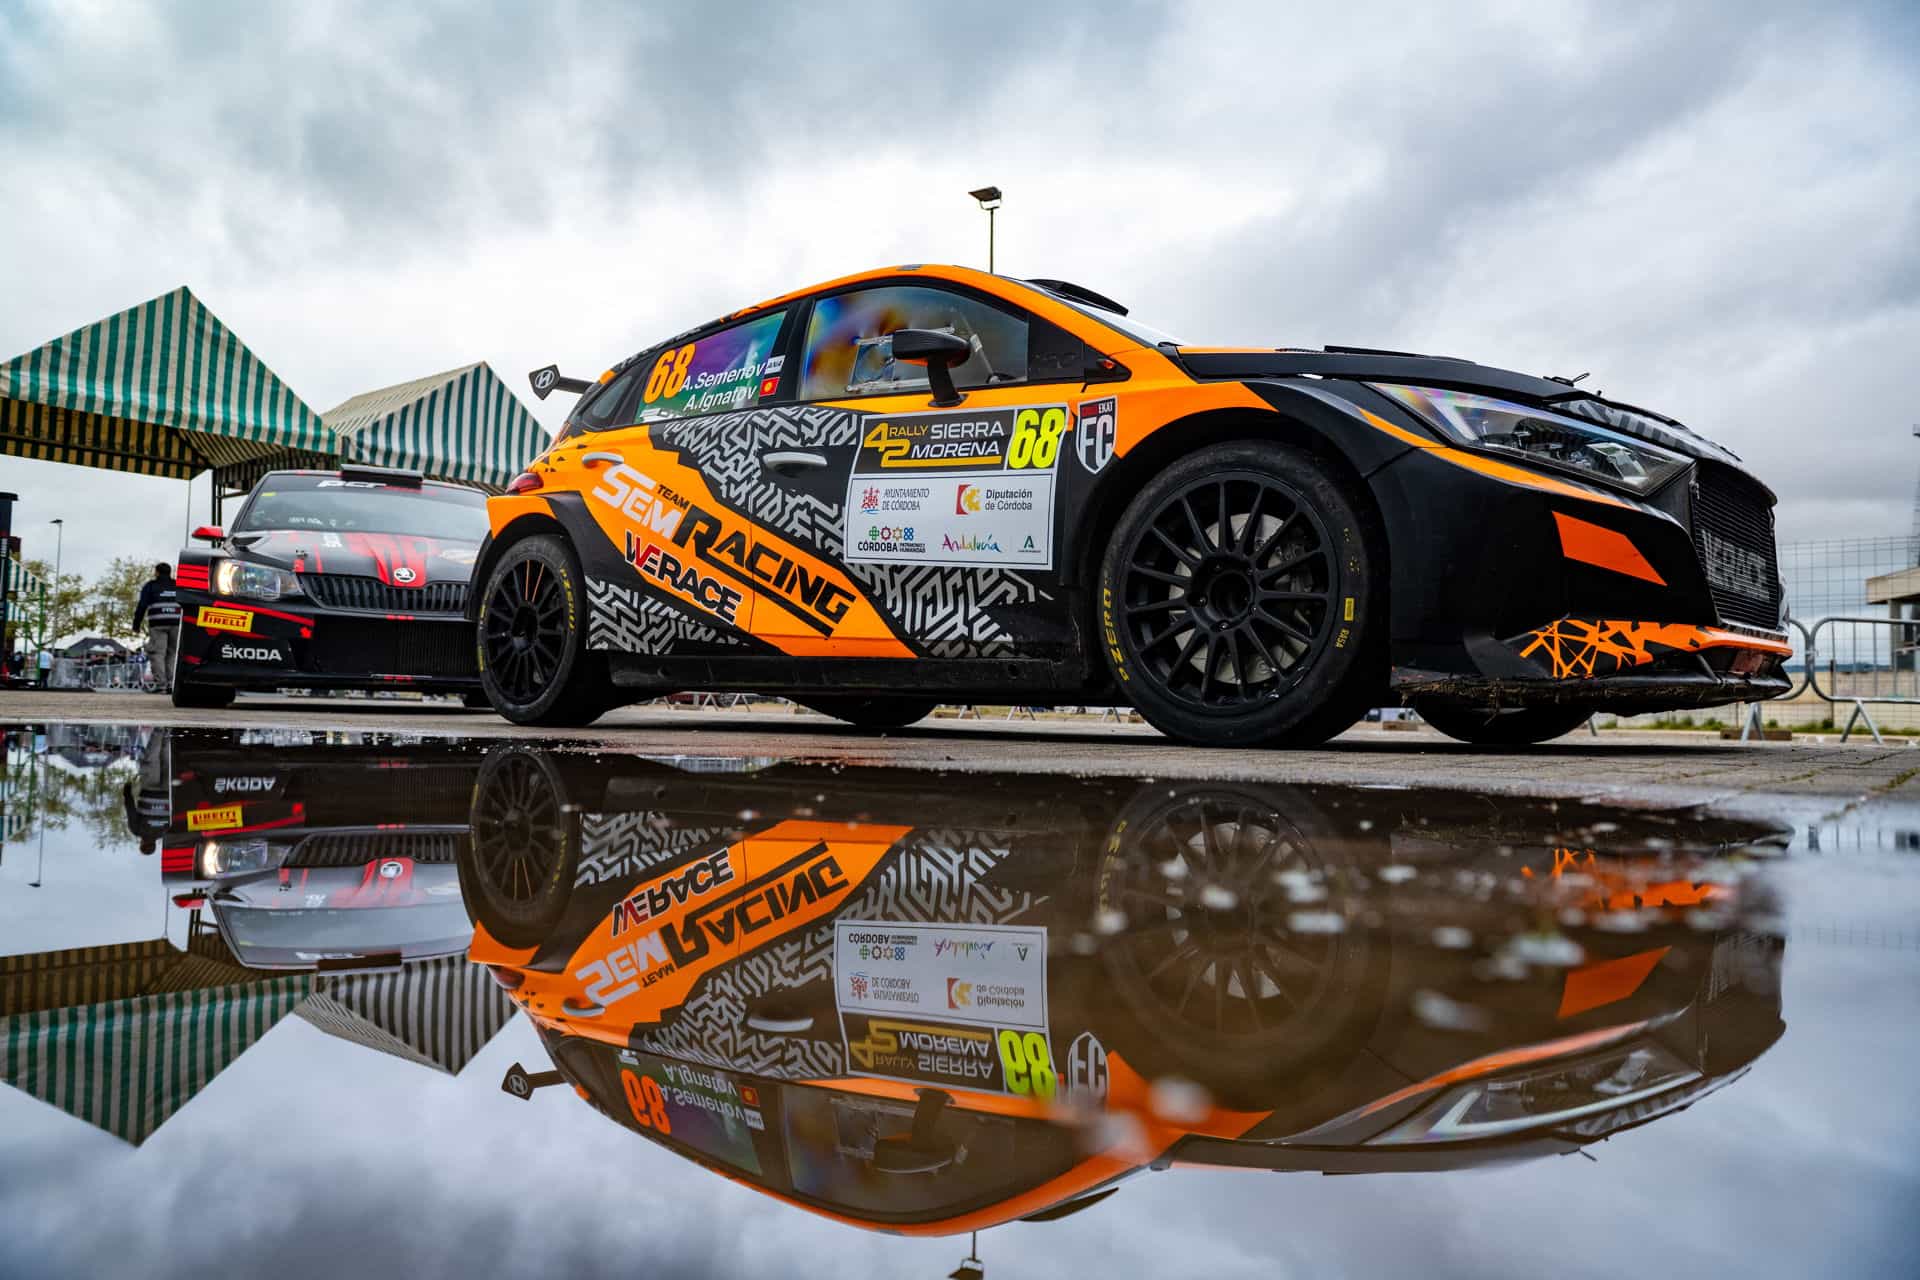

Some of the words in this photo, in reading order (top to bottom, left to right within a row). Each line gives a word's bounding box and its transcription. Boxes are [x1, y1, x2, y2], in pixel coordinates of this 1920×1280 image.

[643, 343, 696, 404] 68
[679, 361, 766, 392] A.Semenov
[683, 386, 757, 412] A.Ignatov
[889, 425, 928, 437] RALLY
[931, 421, 1004, 439] SIERRA
[1008, 408, 1067, 469] 68
[911, 441, 1000, 458] MORENA
[1080, 415, 1113, 467] FC
[657, 484, 690, 510] TEAM
[884, 488, 930, 498] AYUNTAMIENTO
[985, 489, 1032, 499] Diputación
[882, 501, 890, 510] DE
[985, 501, 995, 510] de
[625, 529, 743, 625] WERACE
[204, 611, 247, 627] PIRELLI
[222, 644, 283, 661] ŠKODA
